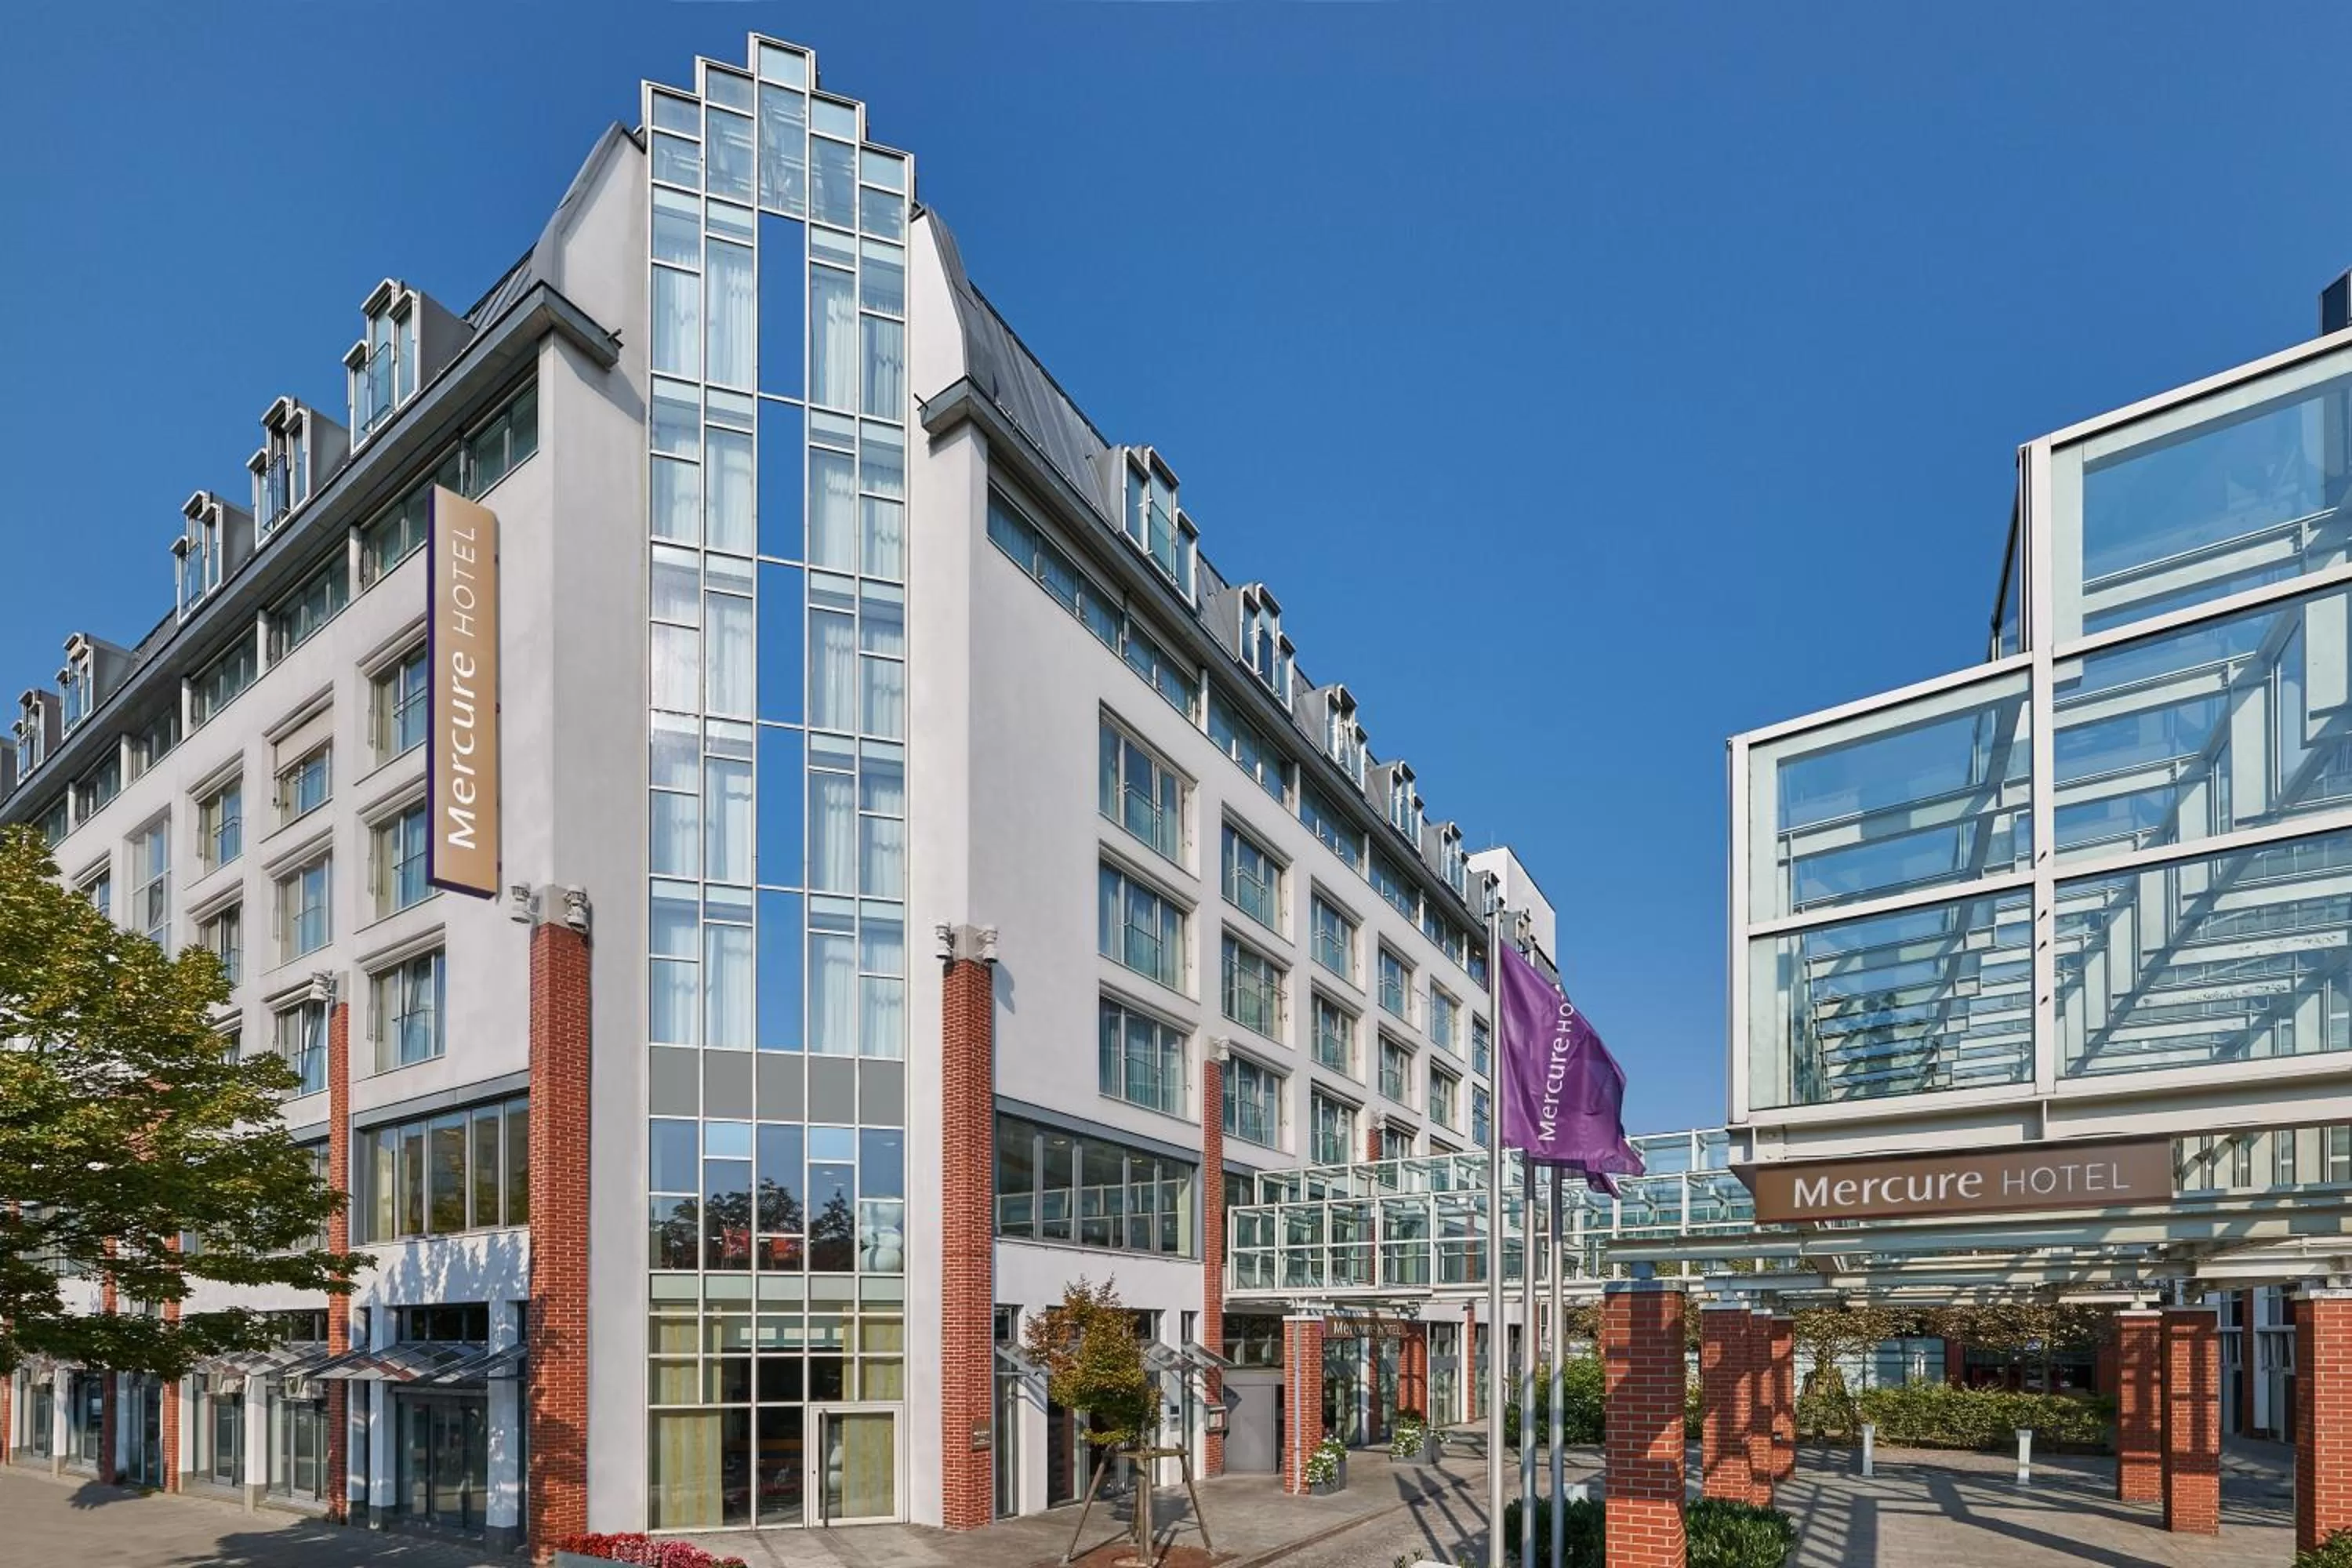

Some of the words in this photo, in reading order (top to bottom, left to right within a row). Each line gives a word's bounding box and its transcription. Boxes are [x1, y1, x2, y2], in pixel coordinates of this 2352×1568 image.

[452, 526, 477, 637] HOTEL
[448, 651, 476, 850] Mercure
[1538, 1037, 1570, 1142] Mercure
[1793, 1171, 1983, 1209] Mercure
[2002, 1162, 2132, 1196] HOTEL
